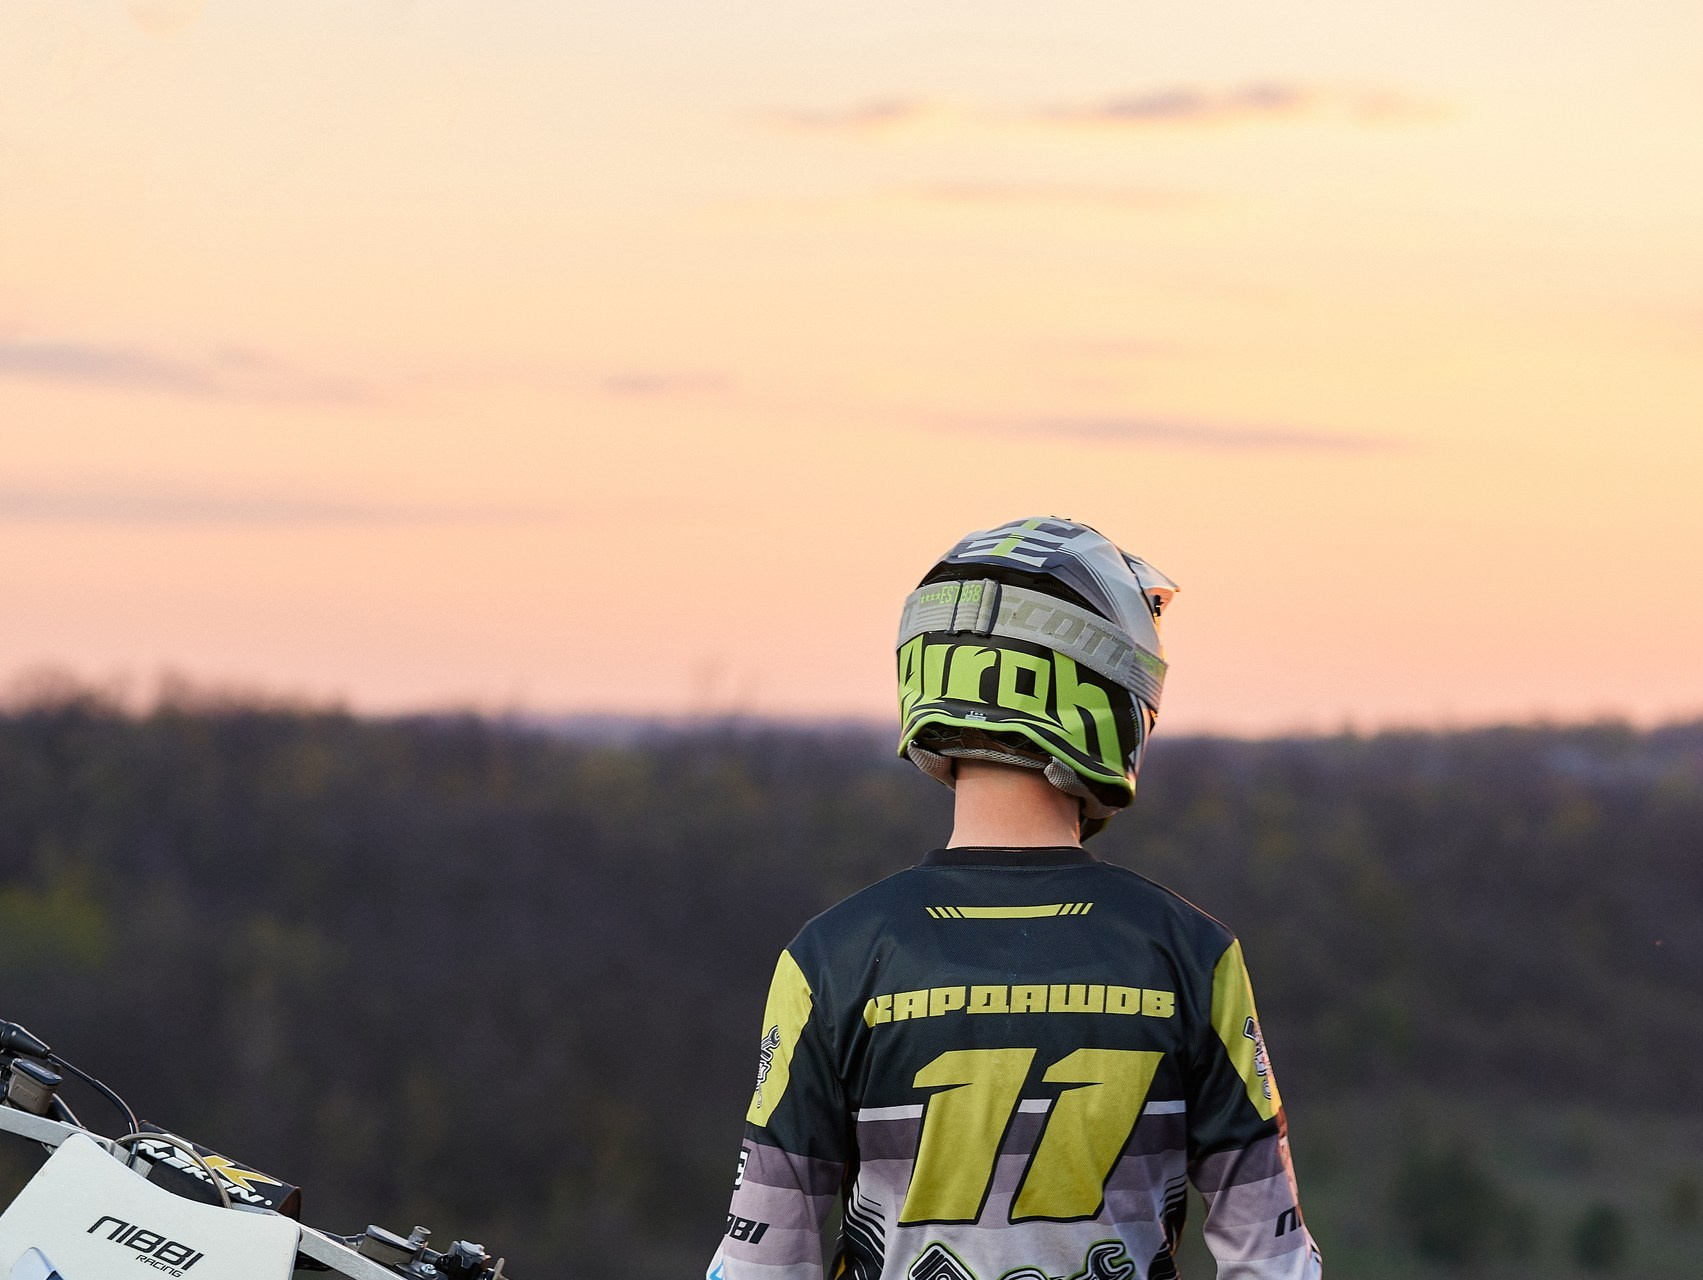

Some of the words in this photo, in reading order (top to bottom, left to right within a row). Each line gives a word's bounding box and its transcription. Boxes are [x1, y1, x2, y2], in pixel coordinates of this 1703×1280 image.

[897, 1048, 1165, 1227] 11
[86, 1215, 205, 1271] NIBBI
[135, 1254, 184, 1278] RACING
